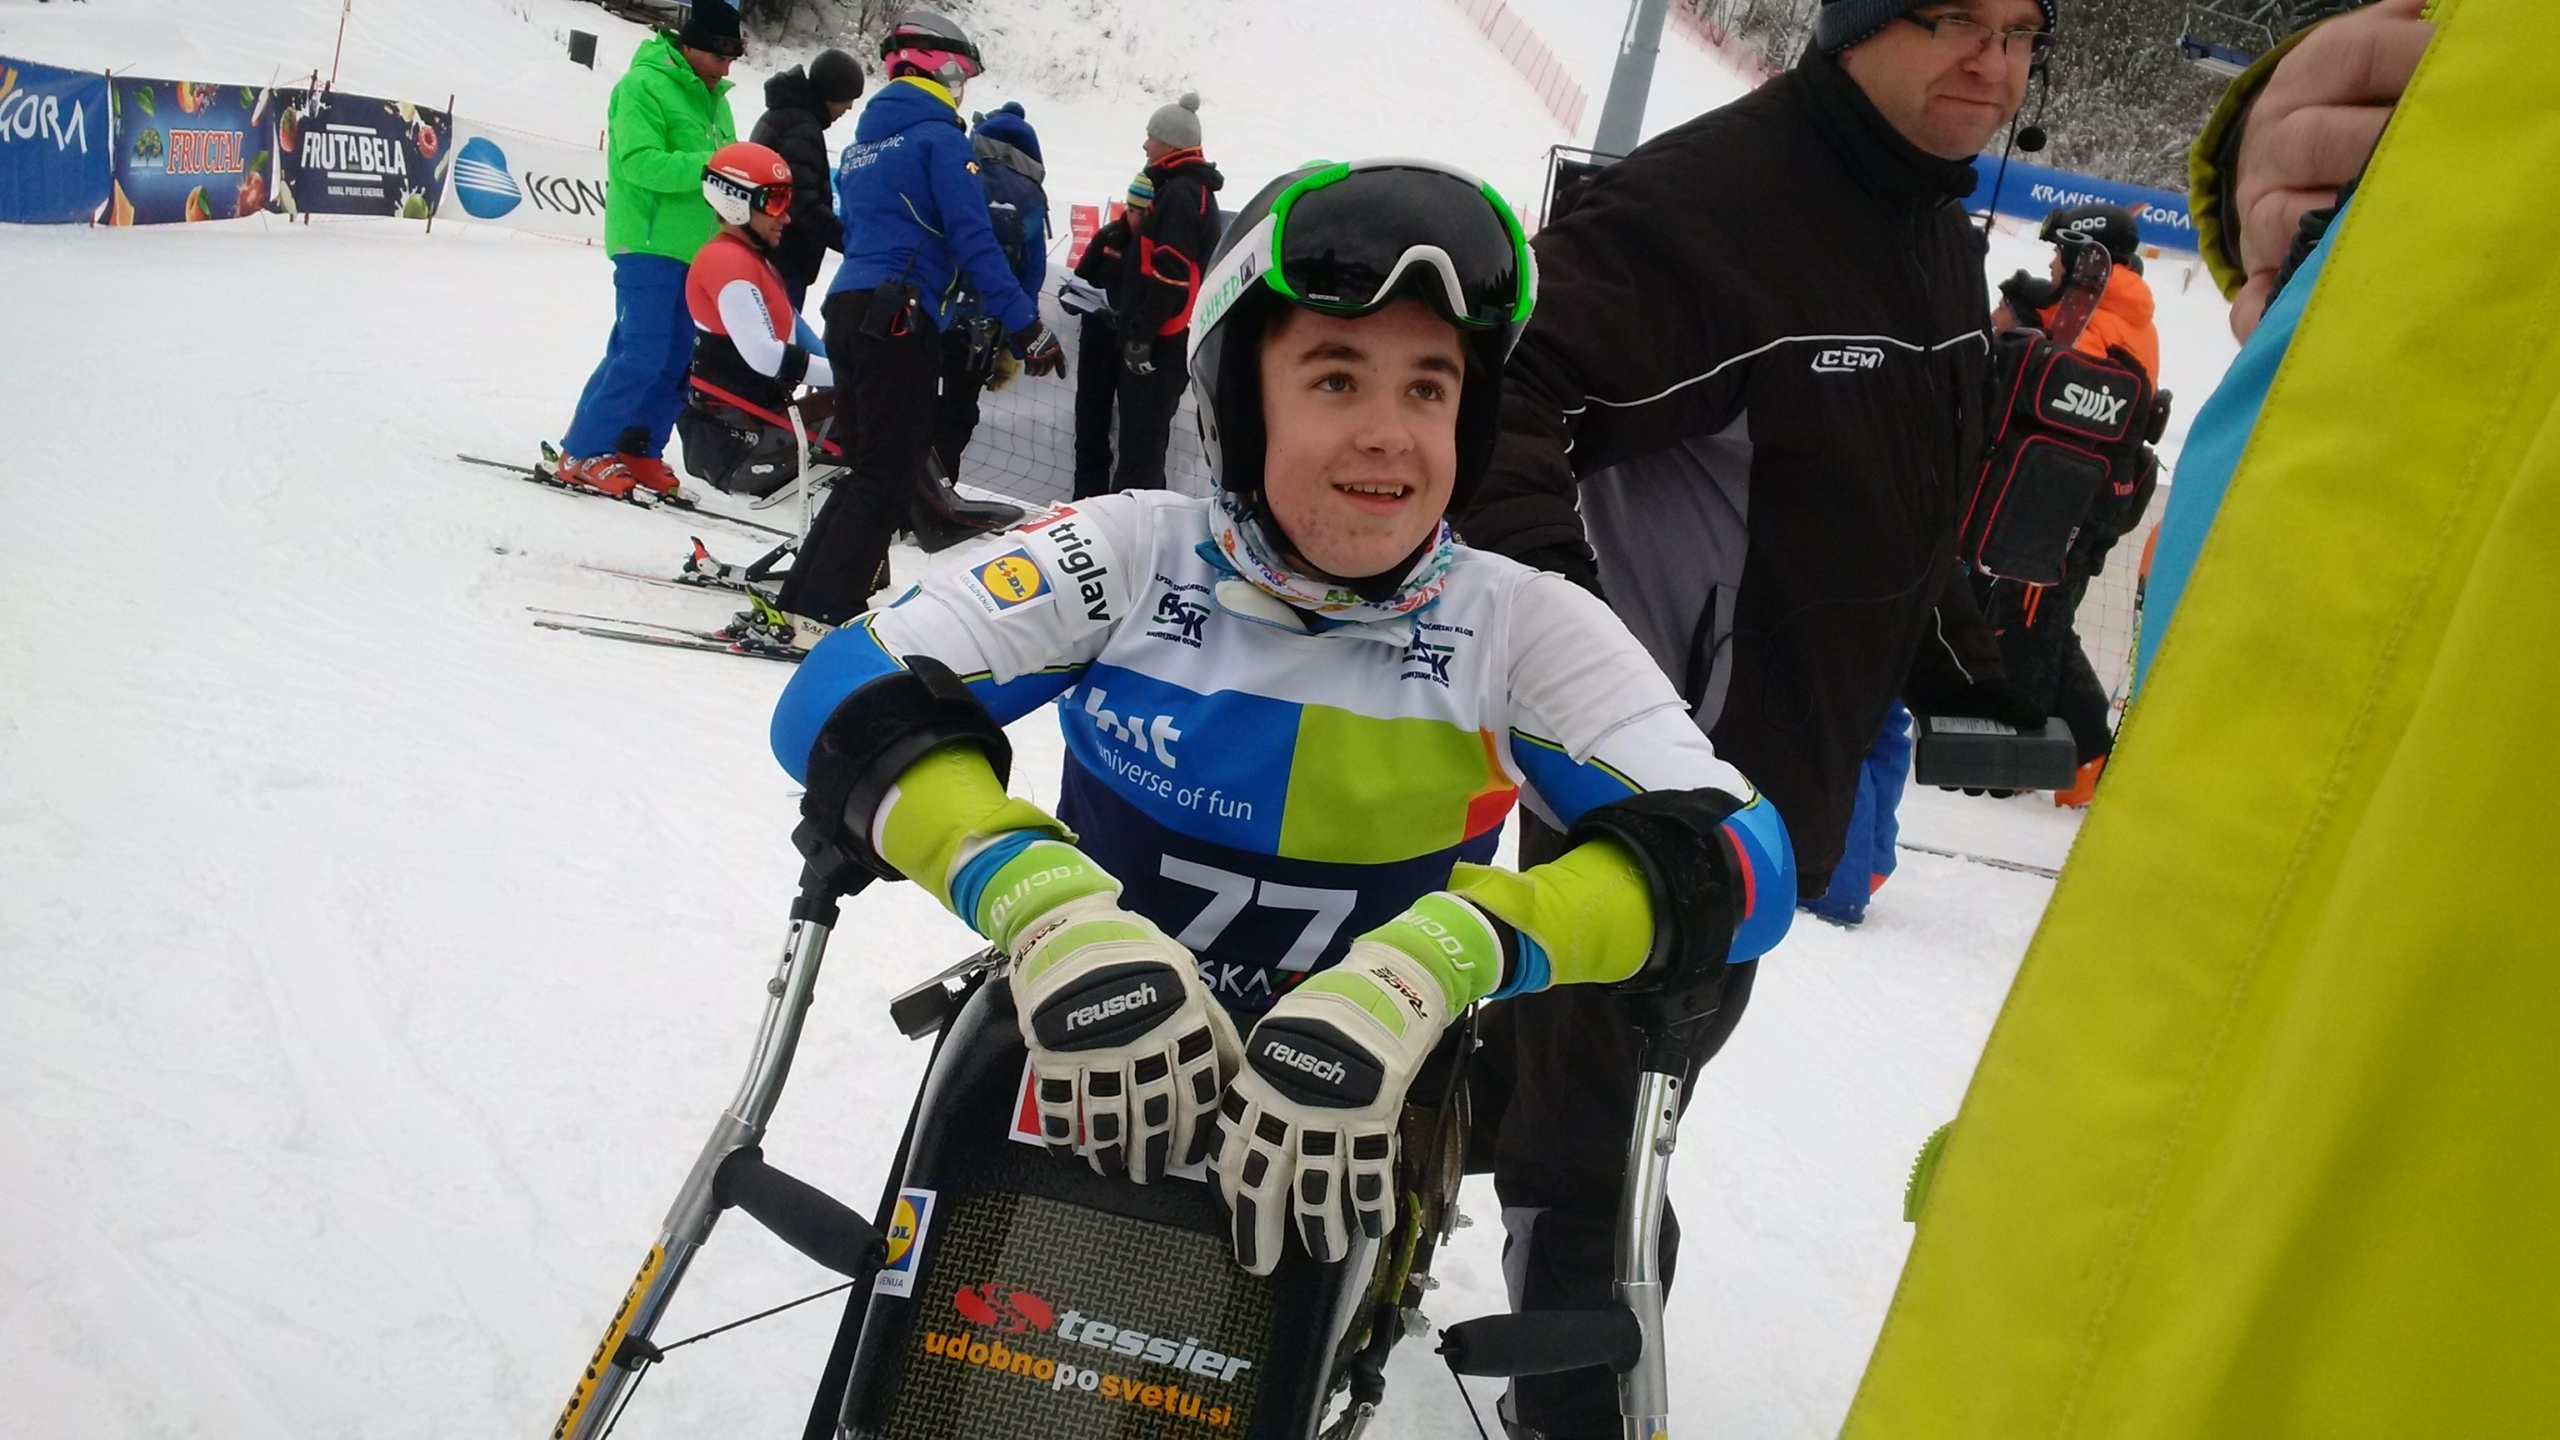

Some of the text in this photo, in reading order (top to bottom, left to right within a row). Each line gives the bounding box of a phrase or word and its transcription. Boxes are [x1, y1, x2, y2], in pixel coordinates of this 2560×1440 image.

[0, 89, 87, 154] GORA
[166, 129, 244, 175] FRUCTAL
[301, 131, 406, 176] FRUTABELA
[526, 171, 609, 216] KON
[707, 174, 752, 202] GIRO
[2031, 183, 2191, 231] KRANJS GORA
[1199, 274, 1240, 335] SHRED
[1821, 350, 1878, 369] CCM
[1048, 521, 1112, 622] triglav
[1096, 740, 1253, 821] universe of fun
[989, 864, 1085, 932] racing
[1158, 853, 1358, 973] 77
[1198, 958, 1272, 998] SKA
[1370, 968, 1428, 1020] RACE
[1065, 982, 1158, 1031] reusch
[1263, 1040, 1347, 1085] reusch
[891, 1225, 911, 1240] DL
[882, 1277, 904, 1288] ENIJA
[1056, 1309, 1252, 1383] tessier
[924, 1330, 1233, 1427] udobnoposvetu.si
